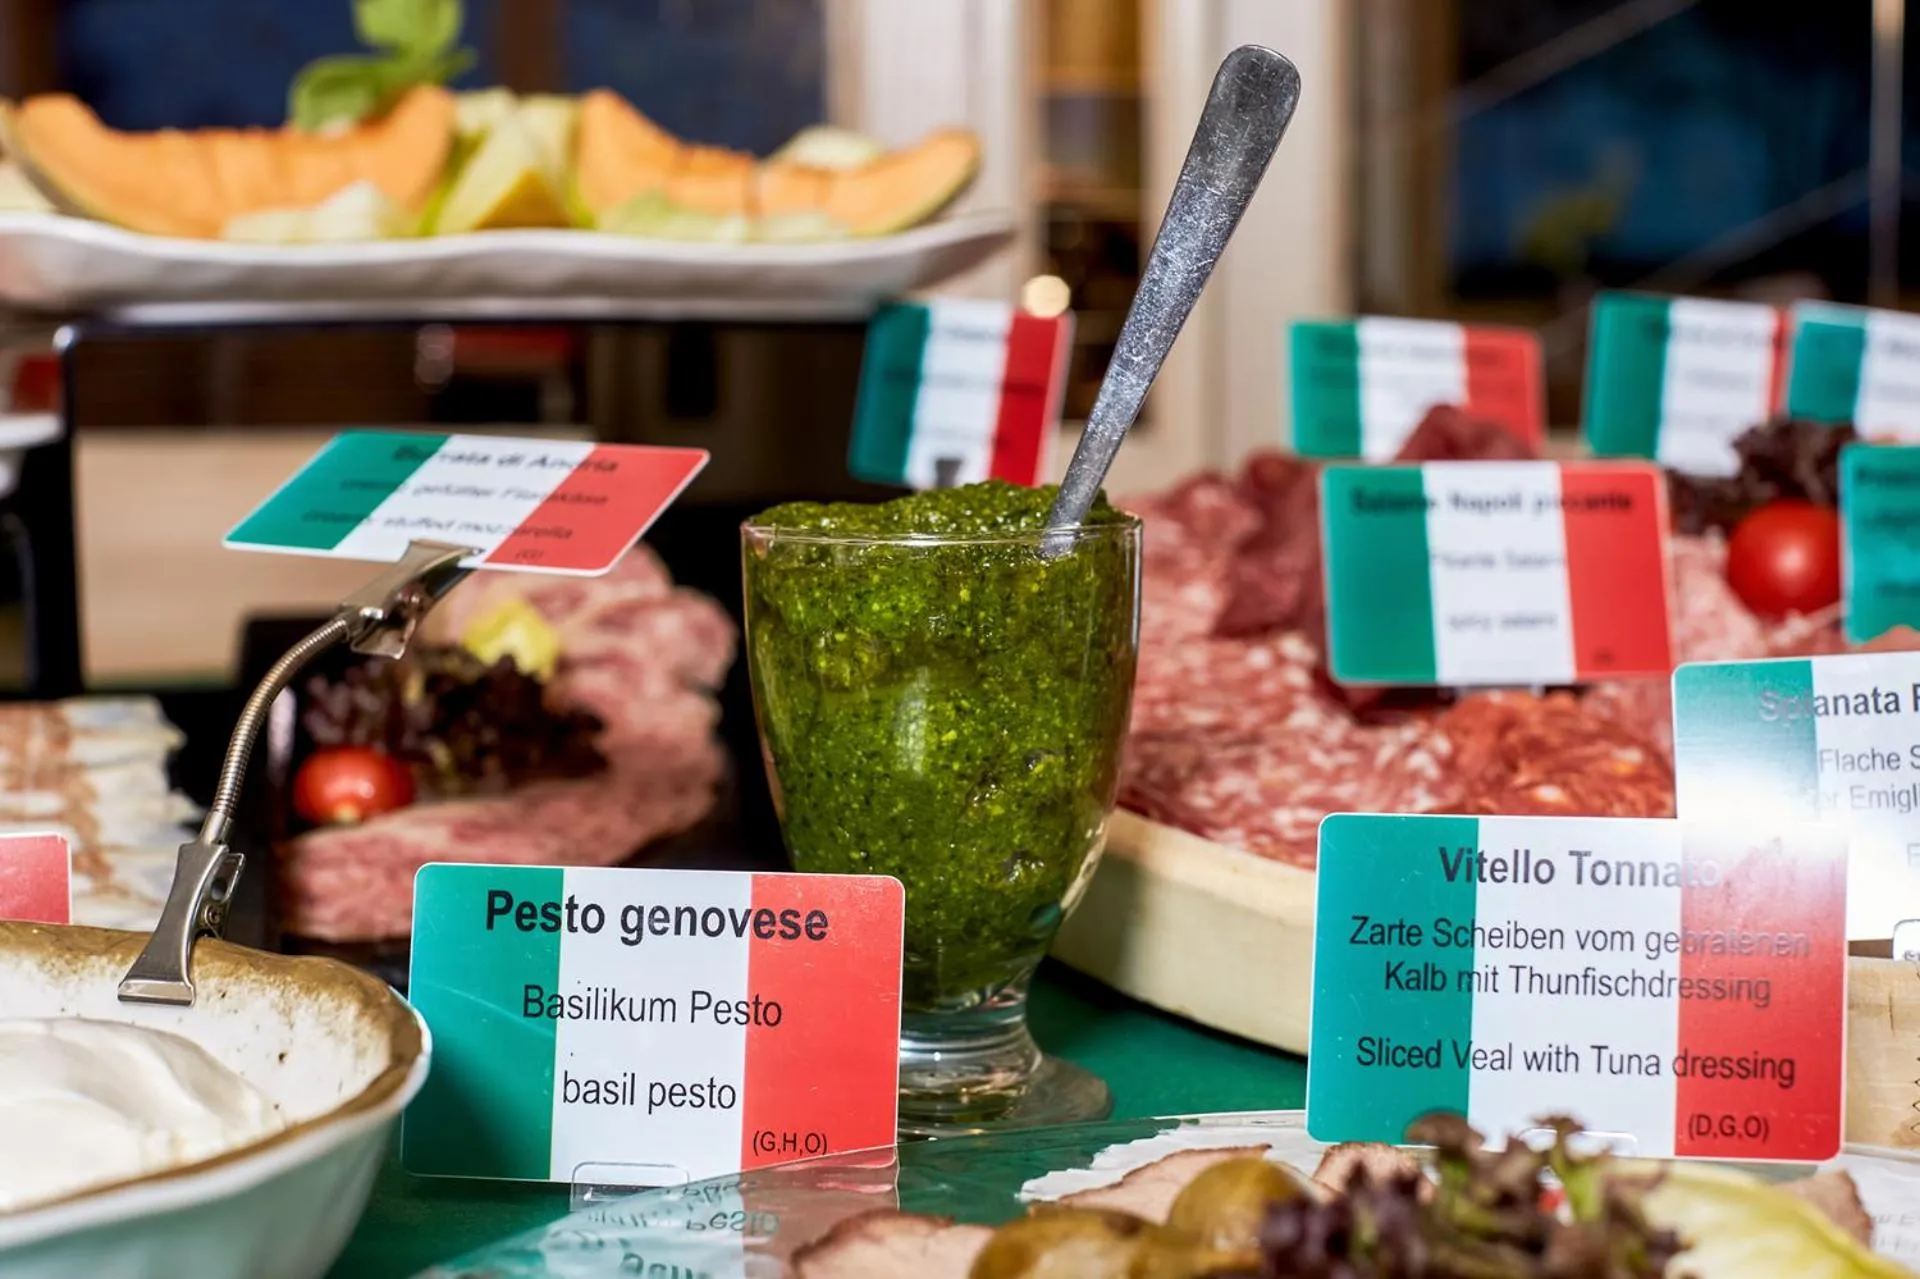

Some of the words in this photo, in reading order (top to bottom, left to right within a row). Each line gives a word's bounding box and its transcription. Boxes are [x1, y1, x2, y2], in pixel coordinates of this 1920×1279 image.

[1818, 746, 1901, 774] Flache
[1438, 845, 1556, 887] Vitello
[1567, 849, 1722, 889] Tonnato
[485, 889, 606, 934] Pesto
[619, 901, 830, 946] genovese
[1349, 915, 1423, 949] Zarte
[1431, 917, 1565, 952] Scheiben
[1575, 927, 1635, 953] vom
[1645, 925, 1811, 960] gebratenen
[522, 984, 678, 1024] Basilikum
[690, 989, 783, 1028] Pesto
[1384, 960, 1448, 993] Kalb
[1457, 964, 1500, 995] mit
[1509, 965, 1772, 1009] Thunfischdressing
[1355, 1036, 1442, 1070] Sliced
[1451, 1040, 1513, 1073] Veal
[1523, 1044, 1580, 1075] with
[1591, 1044, 1662, 1077] Tuna
[1672, 1048, 1797, 1090] dressing
[562, 1070, 636, 1106] basil
[647, 1076, 737, 1115] pesto
[752, 1130, 829, 1156] (G,H,O)
[1687, 1113, 1771, 1144] (D,G,O)
